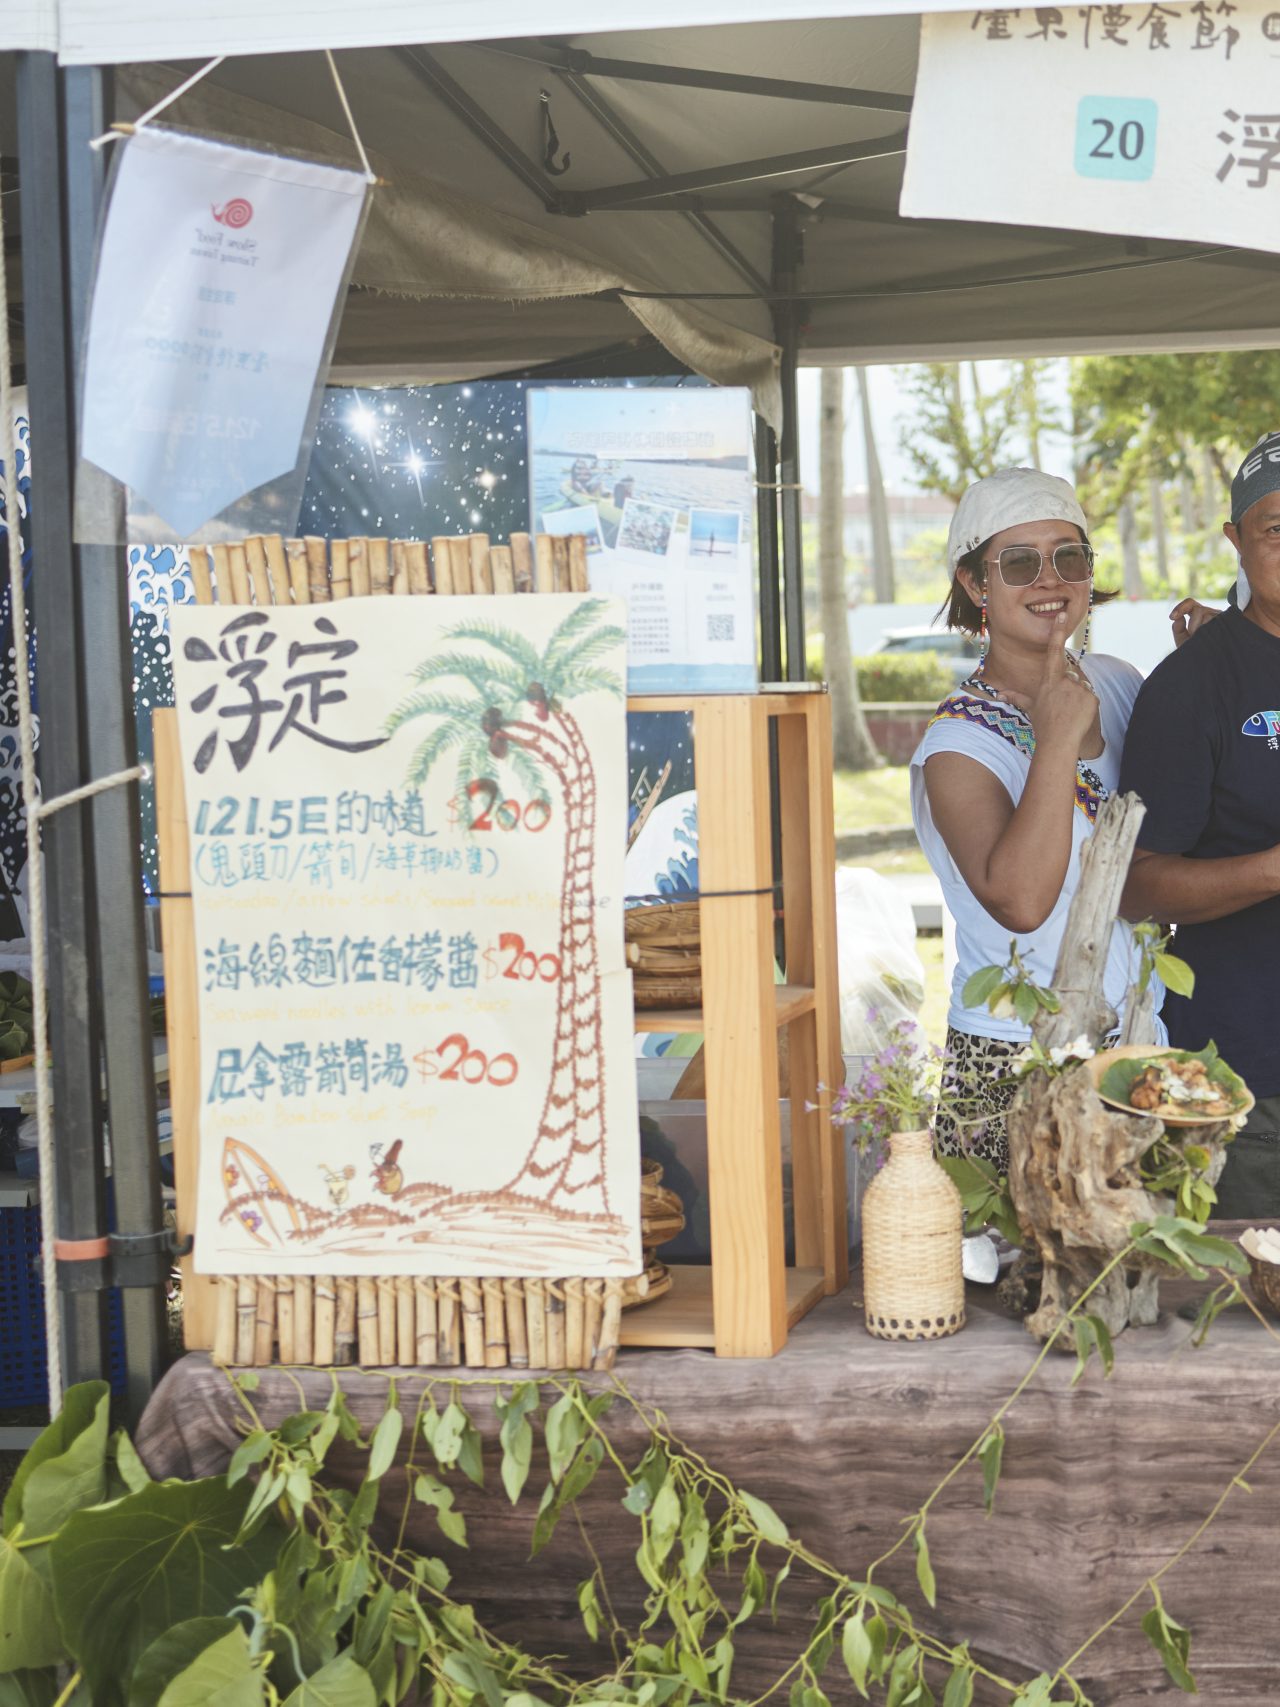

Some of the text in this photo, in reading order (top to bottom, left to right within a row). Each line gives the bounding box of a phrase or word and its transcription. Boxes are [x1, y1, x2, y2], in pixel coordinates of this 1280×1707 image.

[1087, 117, 1146, 161] 20
[183, 611, 391, 775] 浮定
[446, 777, 552, 834] $200
[481, 932, 562, 983] $200
[413, 1032, 519, 1087] $200
